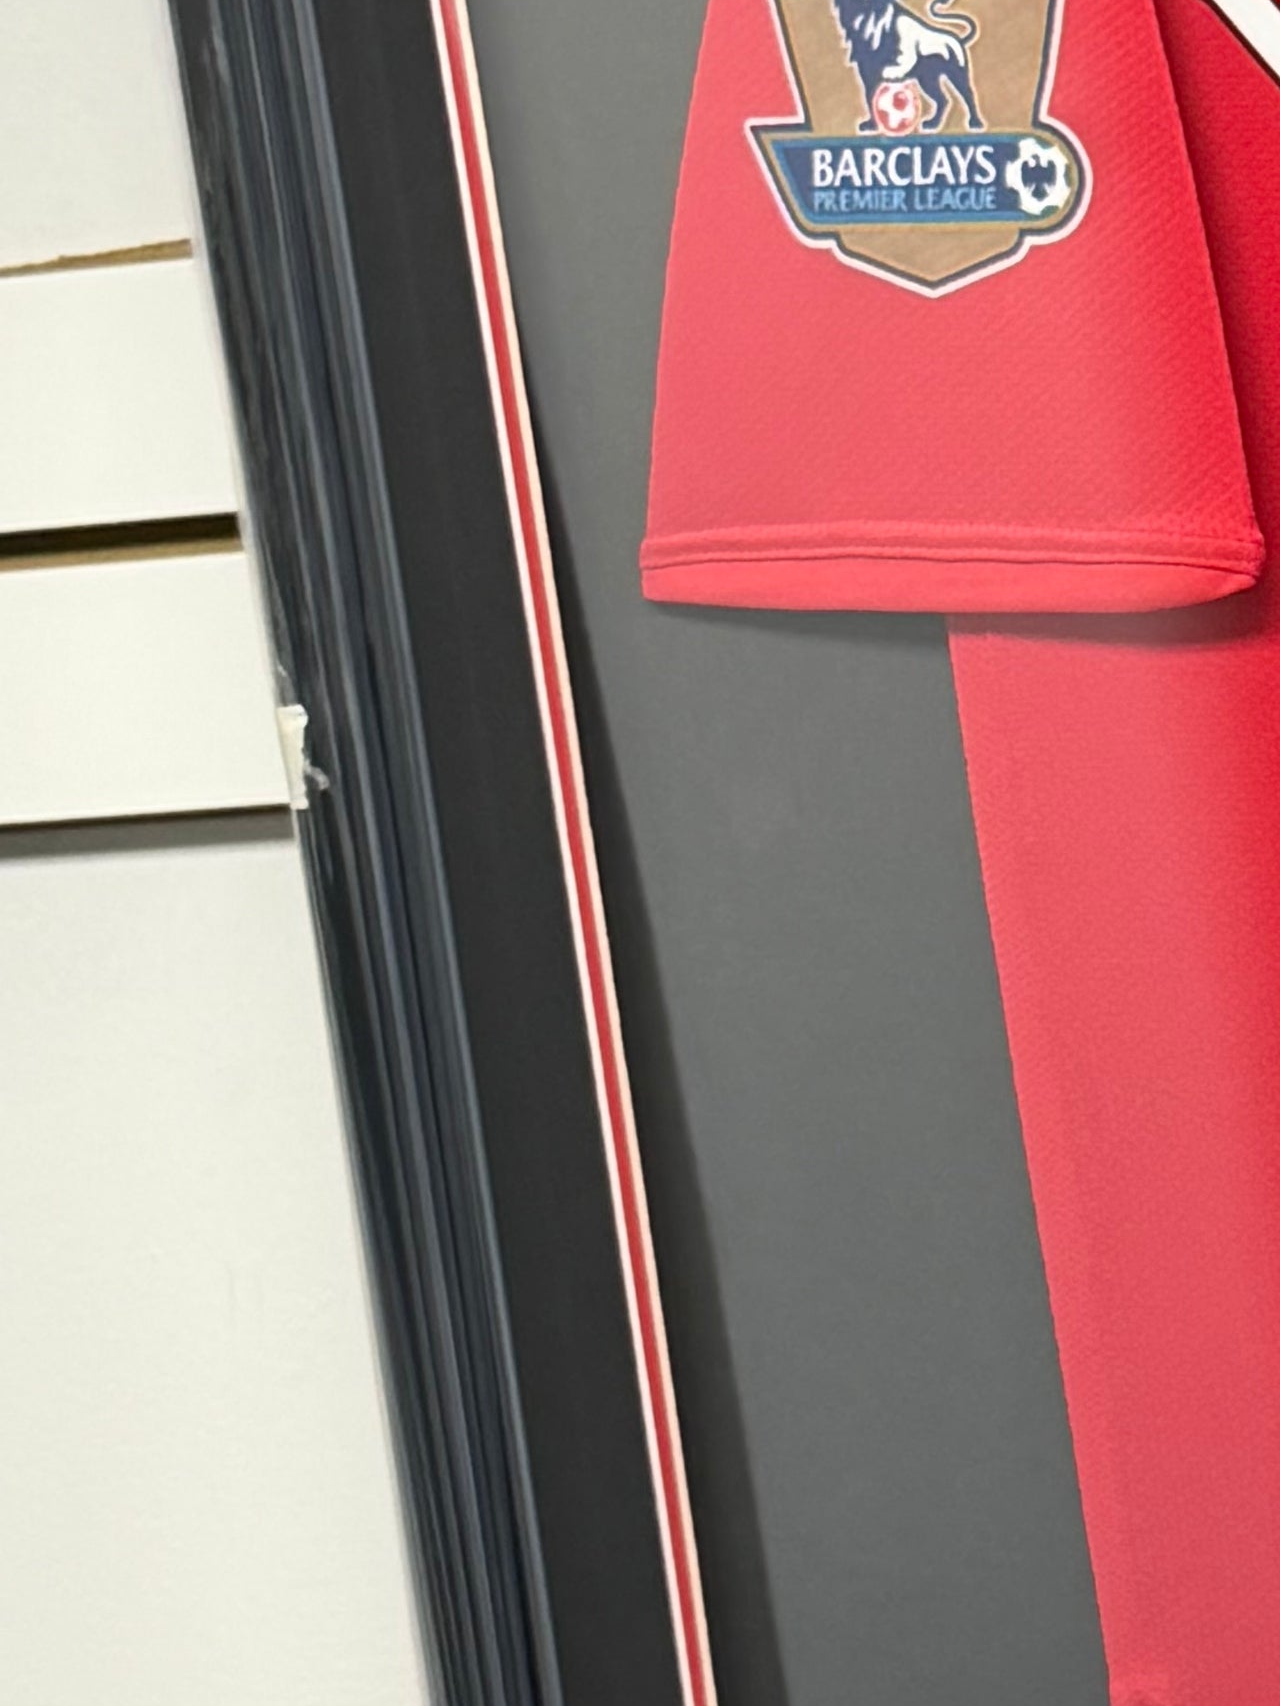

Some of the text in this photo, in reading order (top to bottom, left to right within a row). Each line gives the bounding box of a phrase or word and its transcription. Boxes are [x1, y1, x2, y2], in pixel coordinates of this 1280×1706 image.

[811, 145, 997, 187] BARCLAYS
[812, 187, 997, 213] PREMIER LEAGUE
